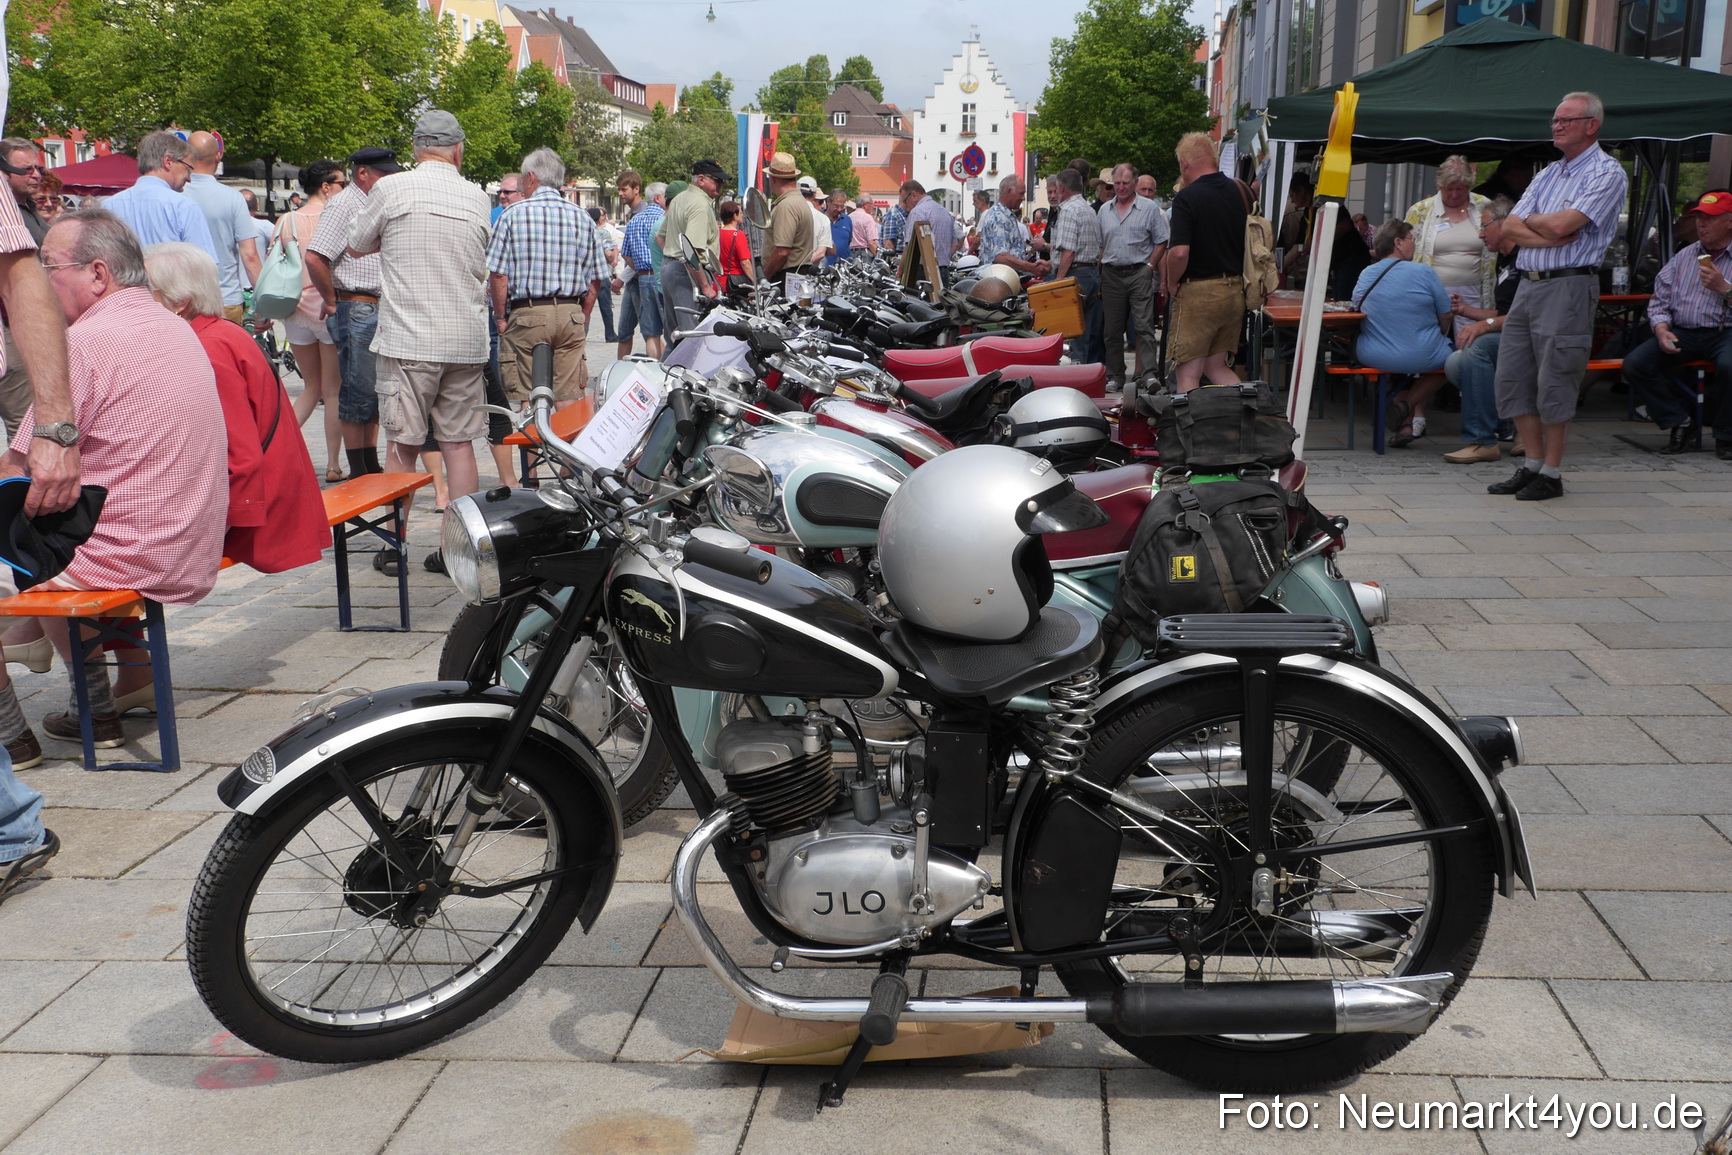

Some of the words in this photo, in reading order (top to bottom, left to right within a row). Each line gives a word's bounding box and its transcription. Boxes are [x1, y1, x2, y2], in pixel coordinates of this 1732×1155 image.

[614, 616, 672, 645] EXPRESS
[860, 701, 897, 715] JLO
[812, 889, 886, 916] JLO
